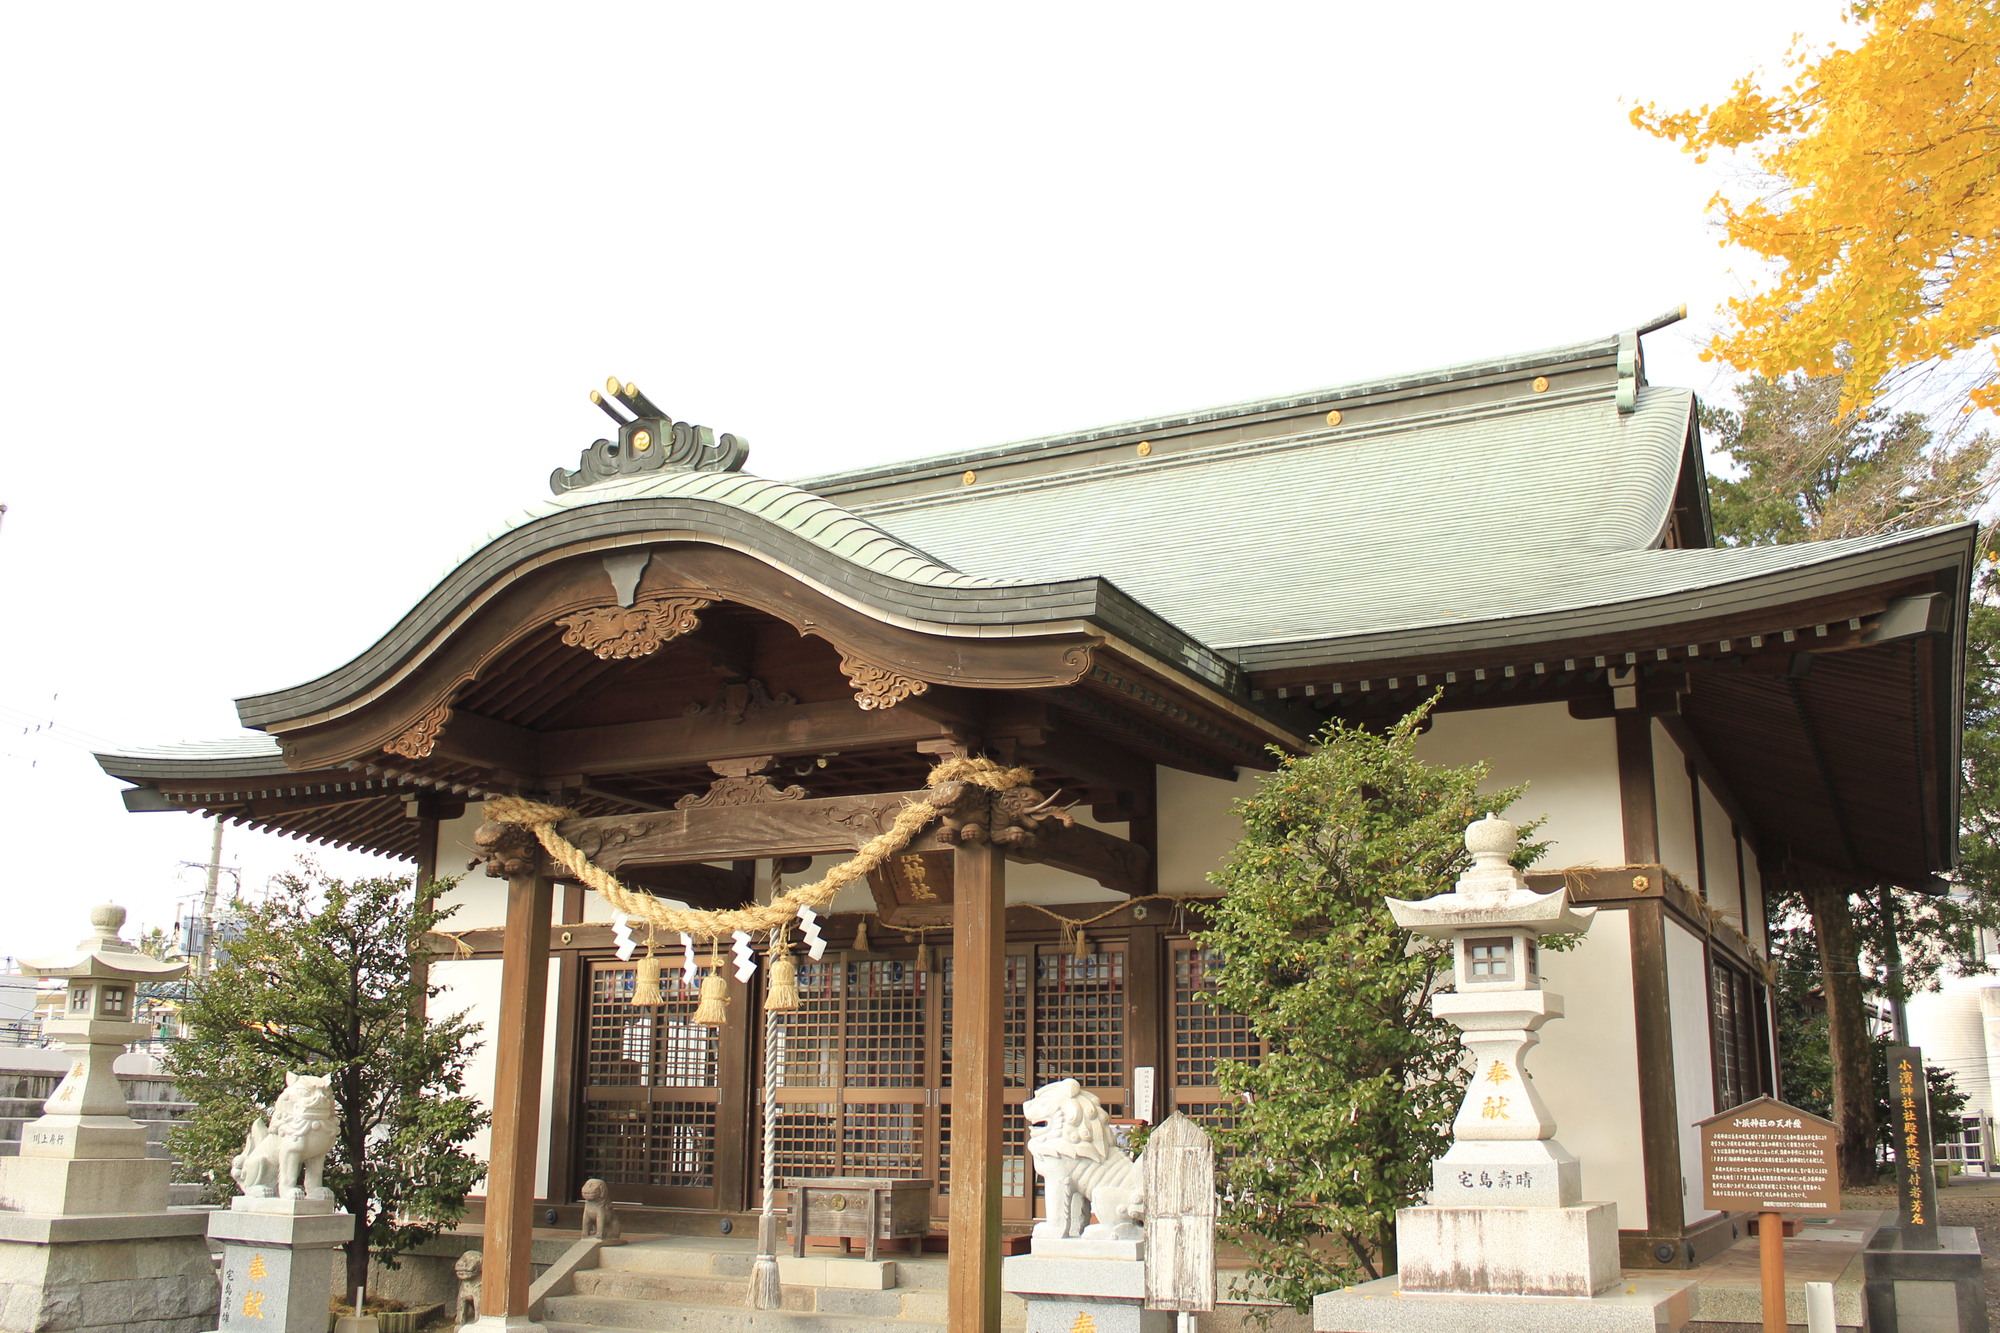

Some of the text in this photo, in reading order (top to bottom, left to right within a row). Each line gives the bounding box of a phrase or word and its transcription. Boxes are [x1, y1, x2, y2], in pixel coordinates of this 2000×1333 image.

[1482, 1060, 1512, 1120] 奉献
[1733, 1118, 1802, 1129] 小浜神社の天井絵
[242, 1253, 268, 1320] 奉献
